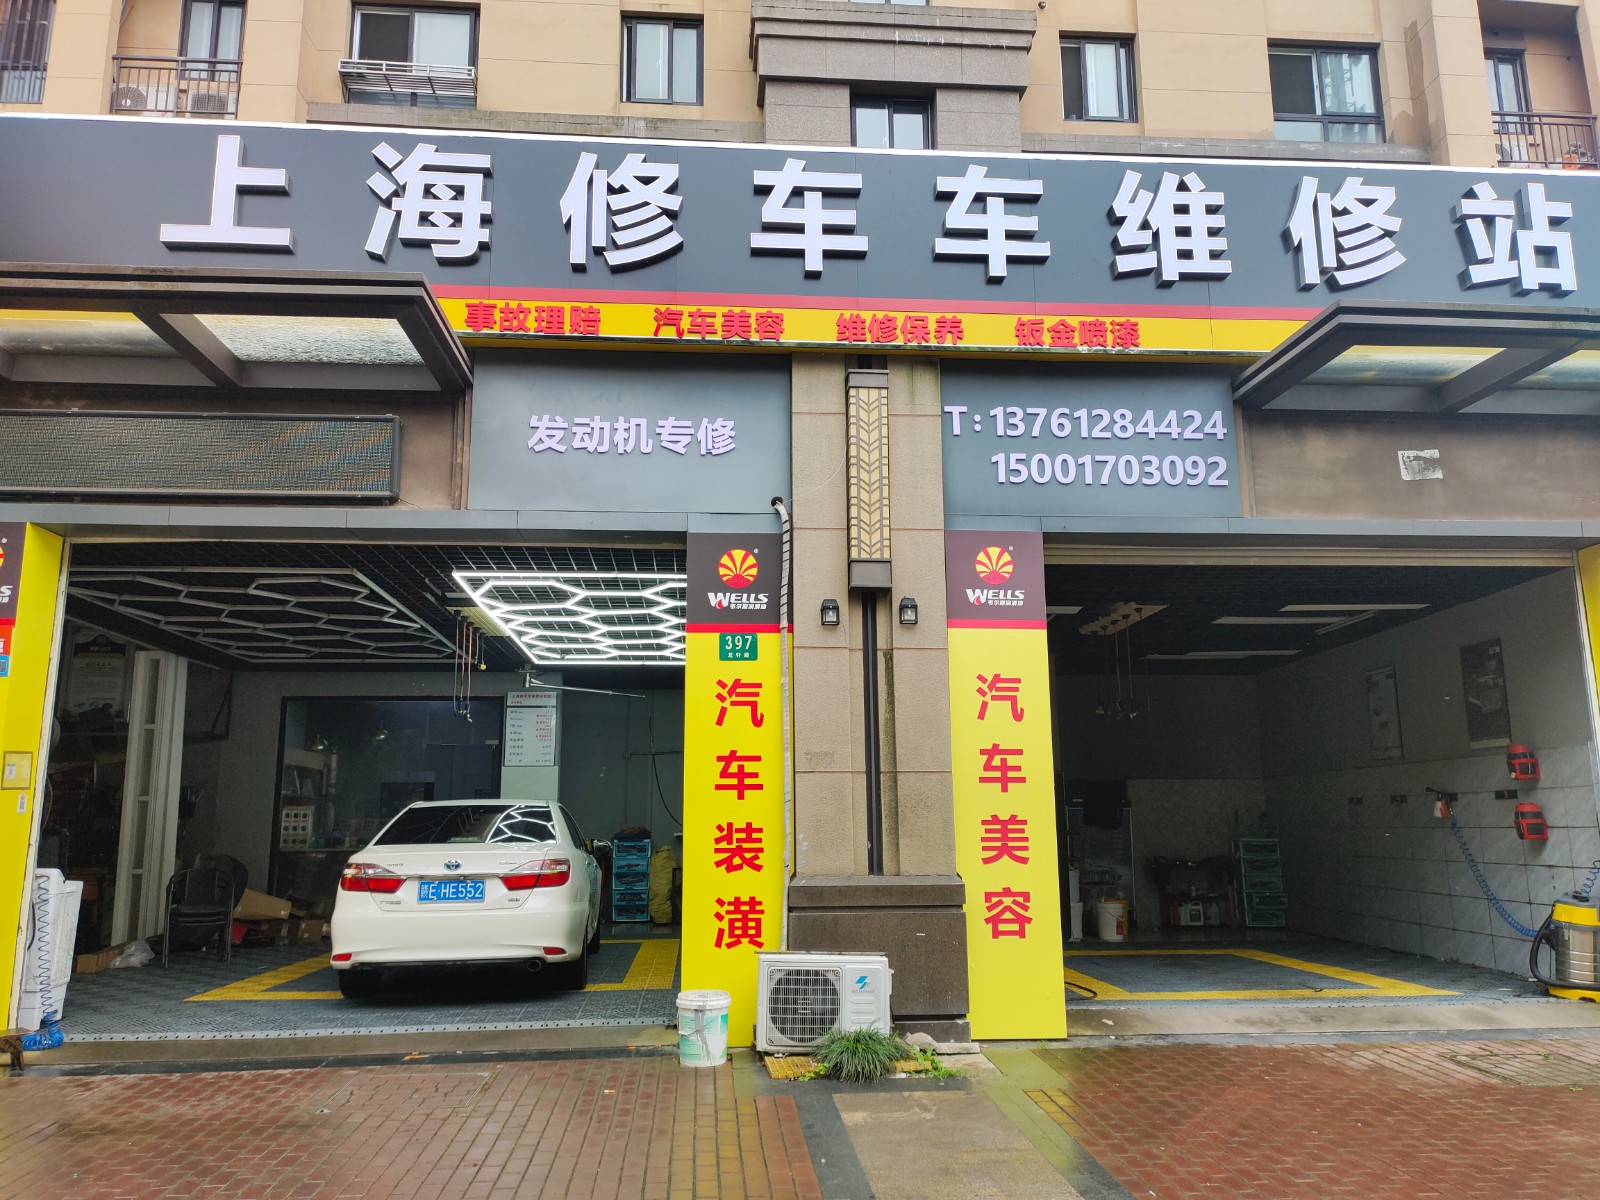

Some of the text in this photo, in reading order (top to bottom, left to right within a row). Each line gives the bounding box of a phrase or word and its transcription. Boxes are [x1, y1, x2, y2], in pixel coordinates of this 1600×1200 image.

[159, 133, 1578, 297] 上海修车车维修站
[464, 301, 1141, 349] 事故理赔 汽车美容 维修保养 钣金喷漆
[526, 414, 737, 456] 发动机专修
[990, 452, 1229, 487] 15001703092
[707, 592, 769, 609] WELLS
[965, 588, 1025, 605] WELLS
[725, 635, 752, 650] 397
[713, 678, 766, 950] 汽车装潢
[975, 673, 1033, 940] 汽车美容
